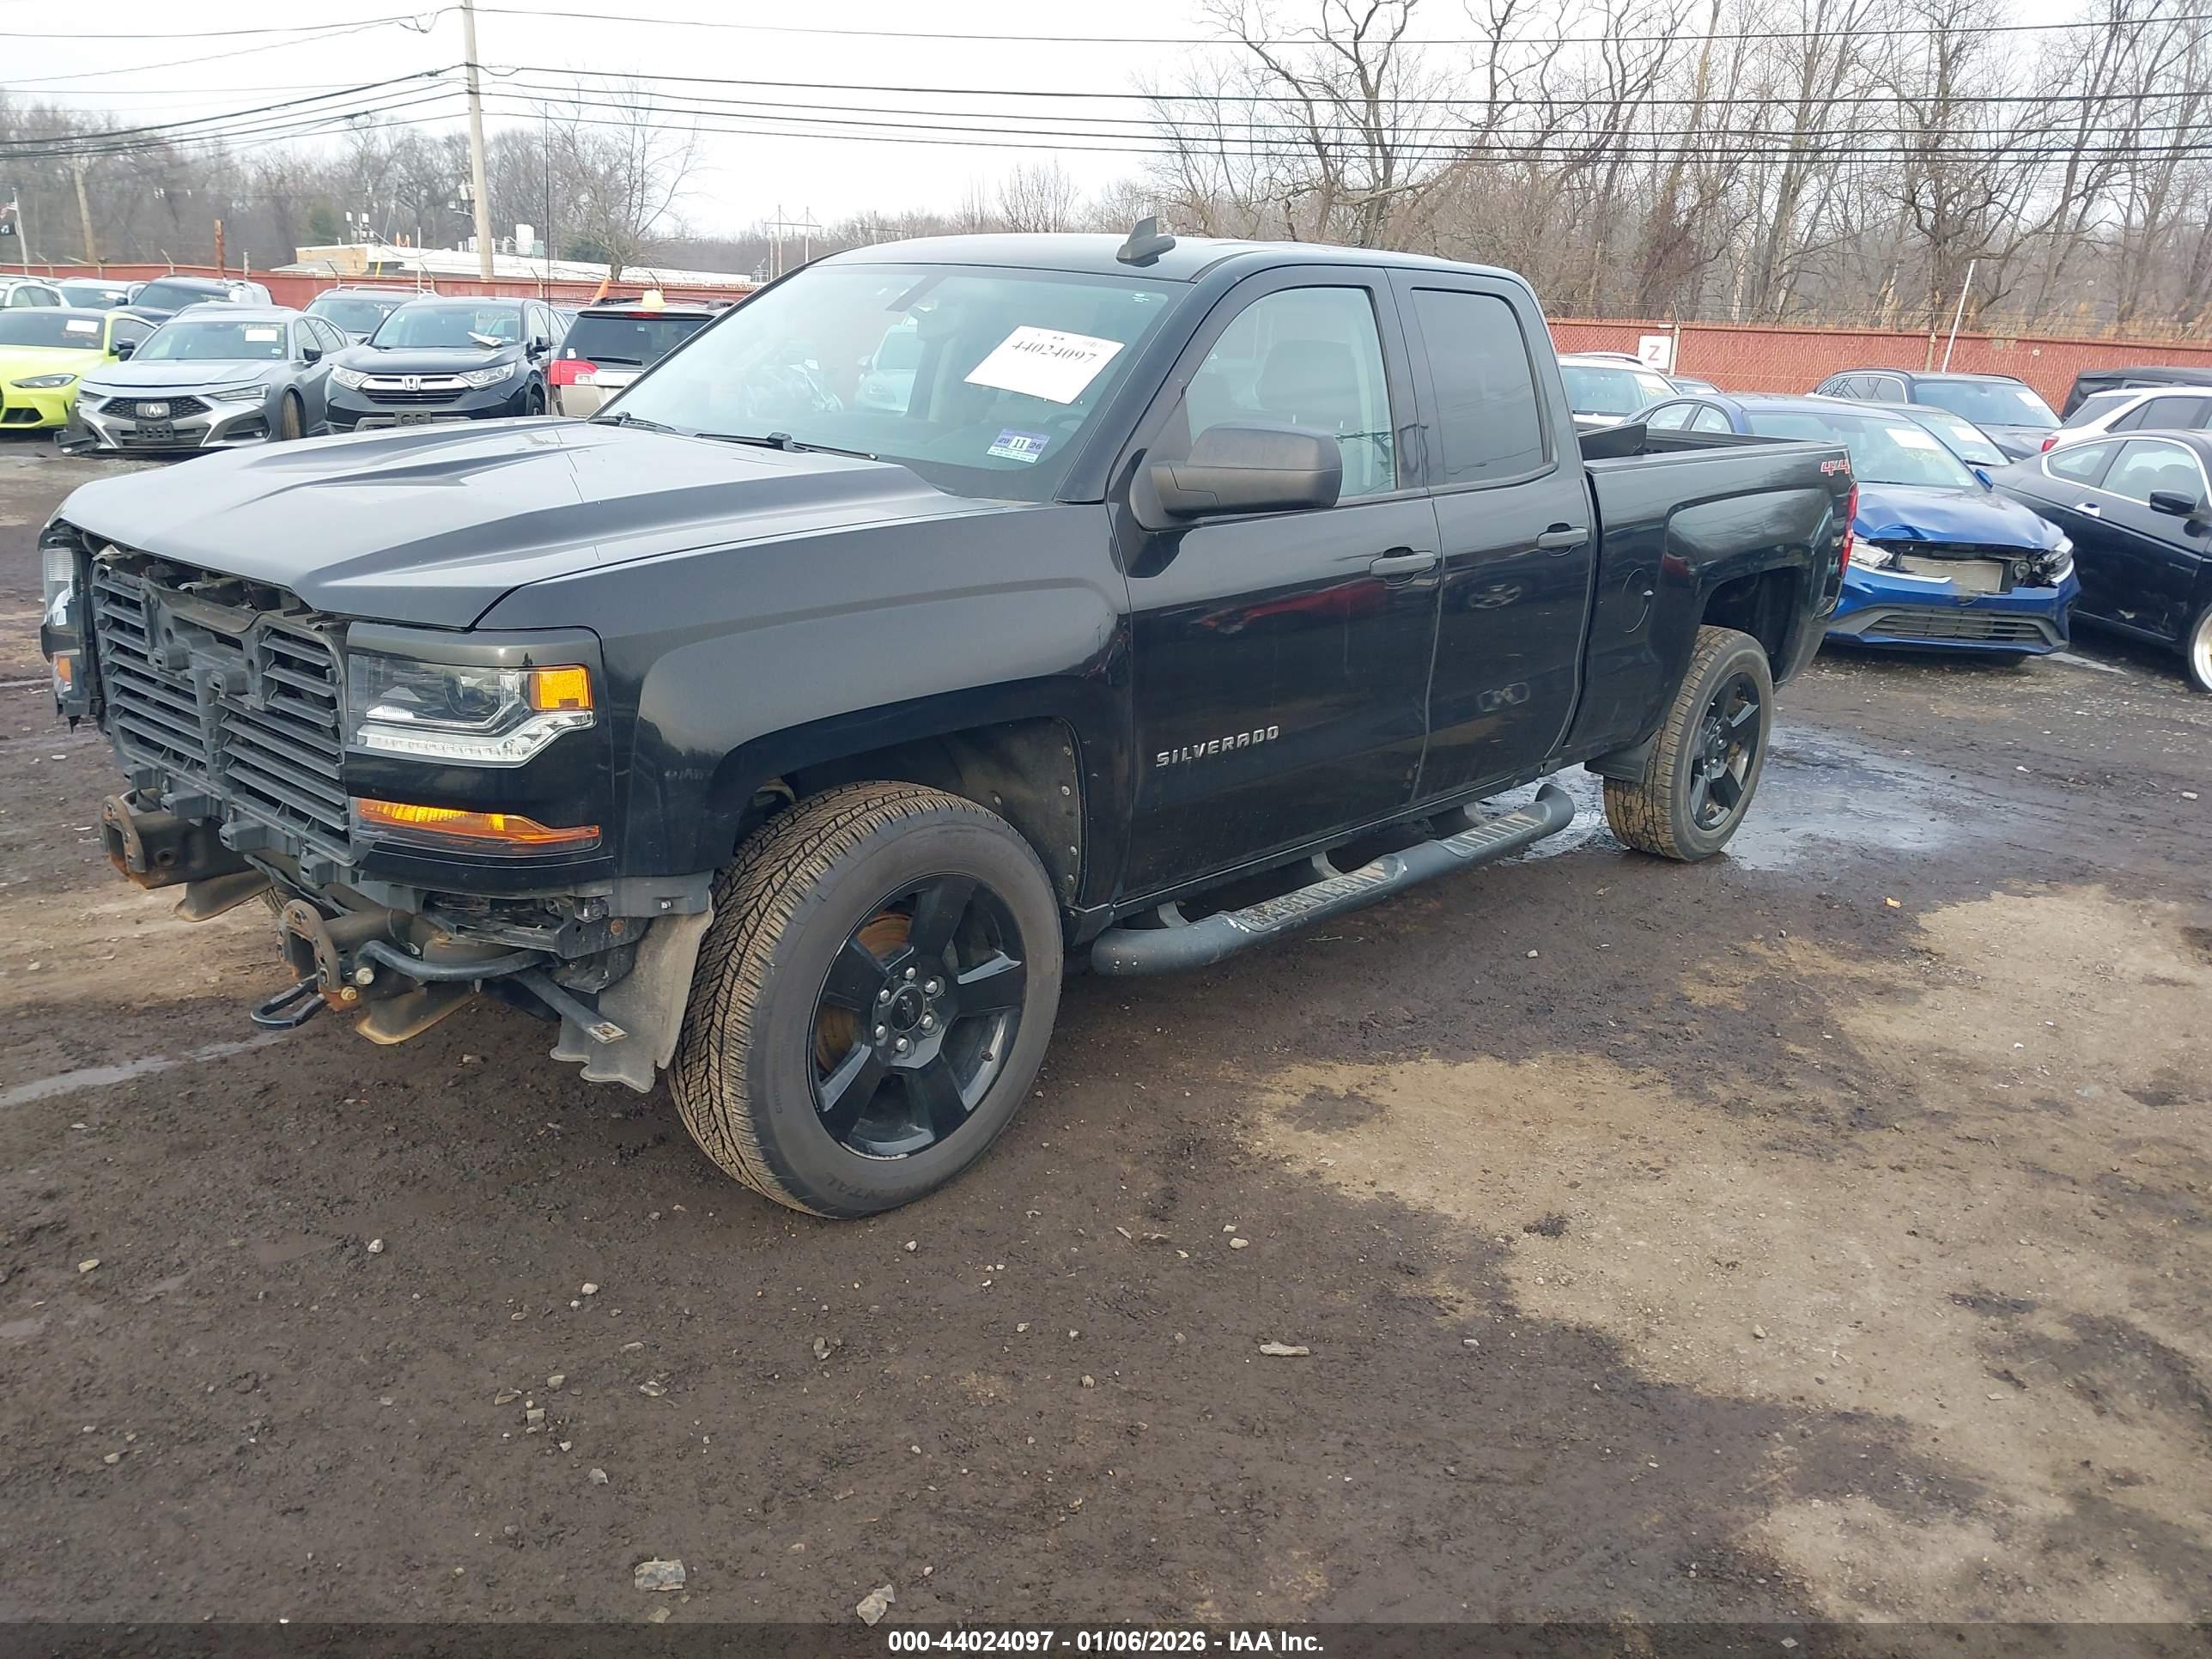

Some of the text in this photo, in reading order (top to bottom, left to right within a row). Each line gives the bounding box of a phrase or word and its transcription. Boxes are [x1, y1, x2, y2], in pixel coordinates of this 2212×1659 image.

[1012, 340, 1097, 363] 44024097
[1647, 344, 1661, 361] Z
[1012, 438, 1027, 449] 11
[1155, 725, 1280, 769] SILVERADO
